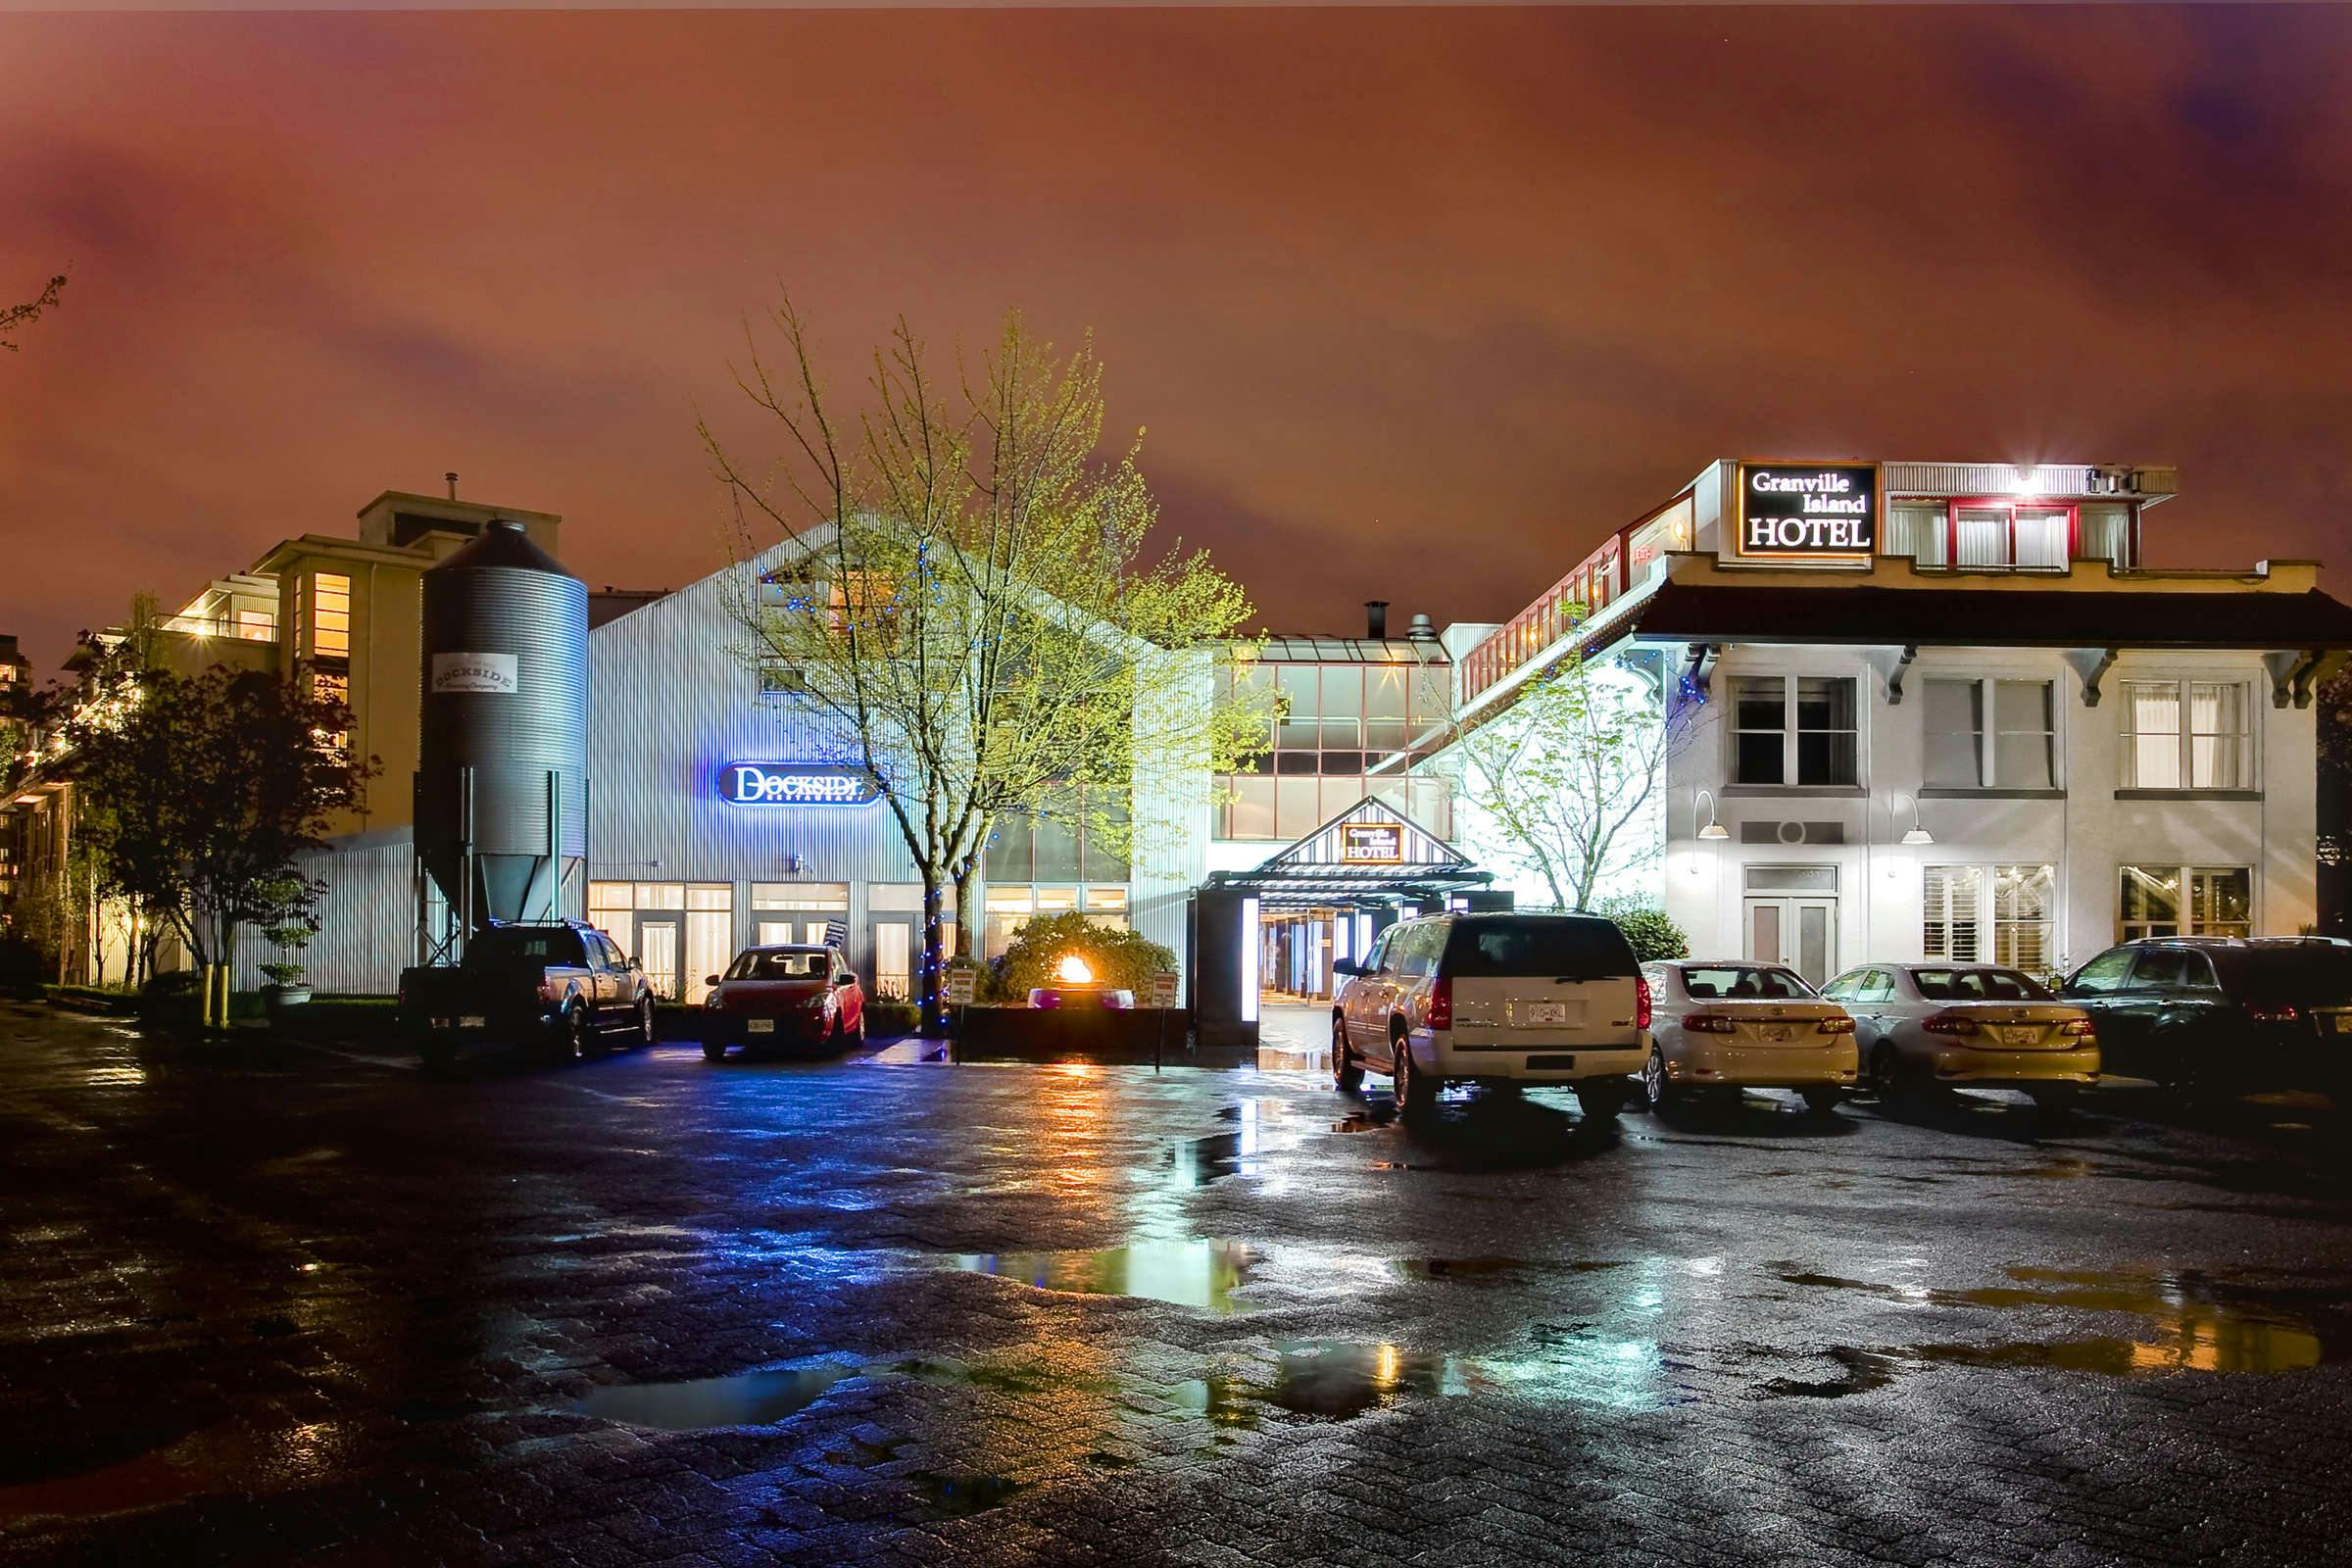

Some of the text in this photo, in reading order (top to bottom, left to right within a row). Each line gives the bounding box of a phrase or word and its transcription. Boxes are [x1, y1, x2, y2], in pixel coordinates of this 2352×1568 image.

[1752, 472, 1850, 492] Granville
[1802, 494, 1866, 513] Island
[1748, 518, 1871, 547] HOTEL
[1347, 847, 1398, 858] HOTEL
